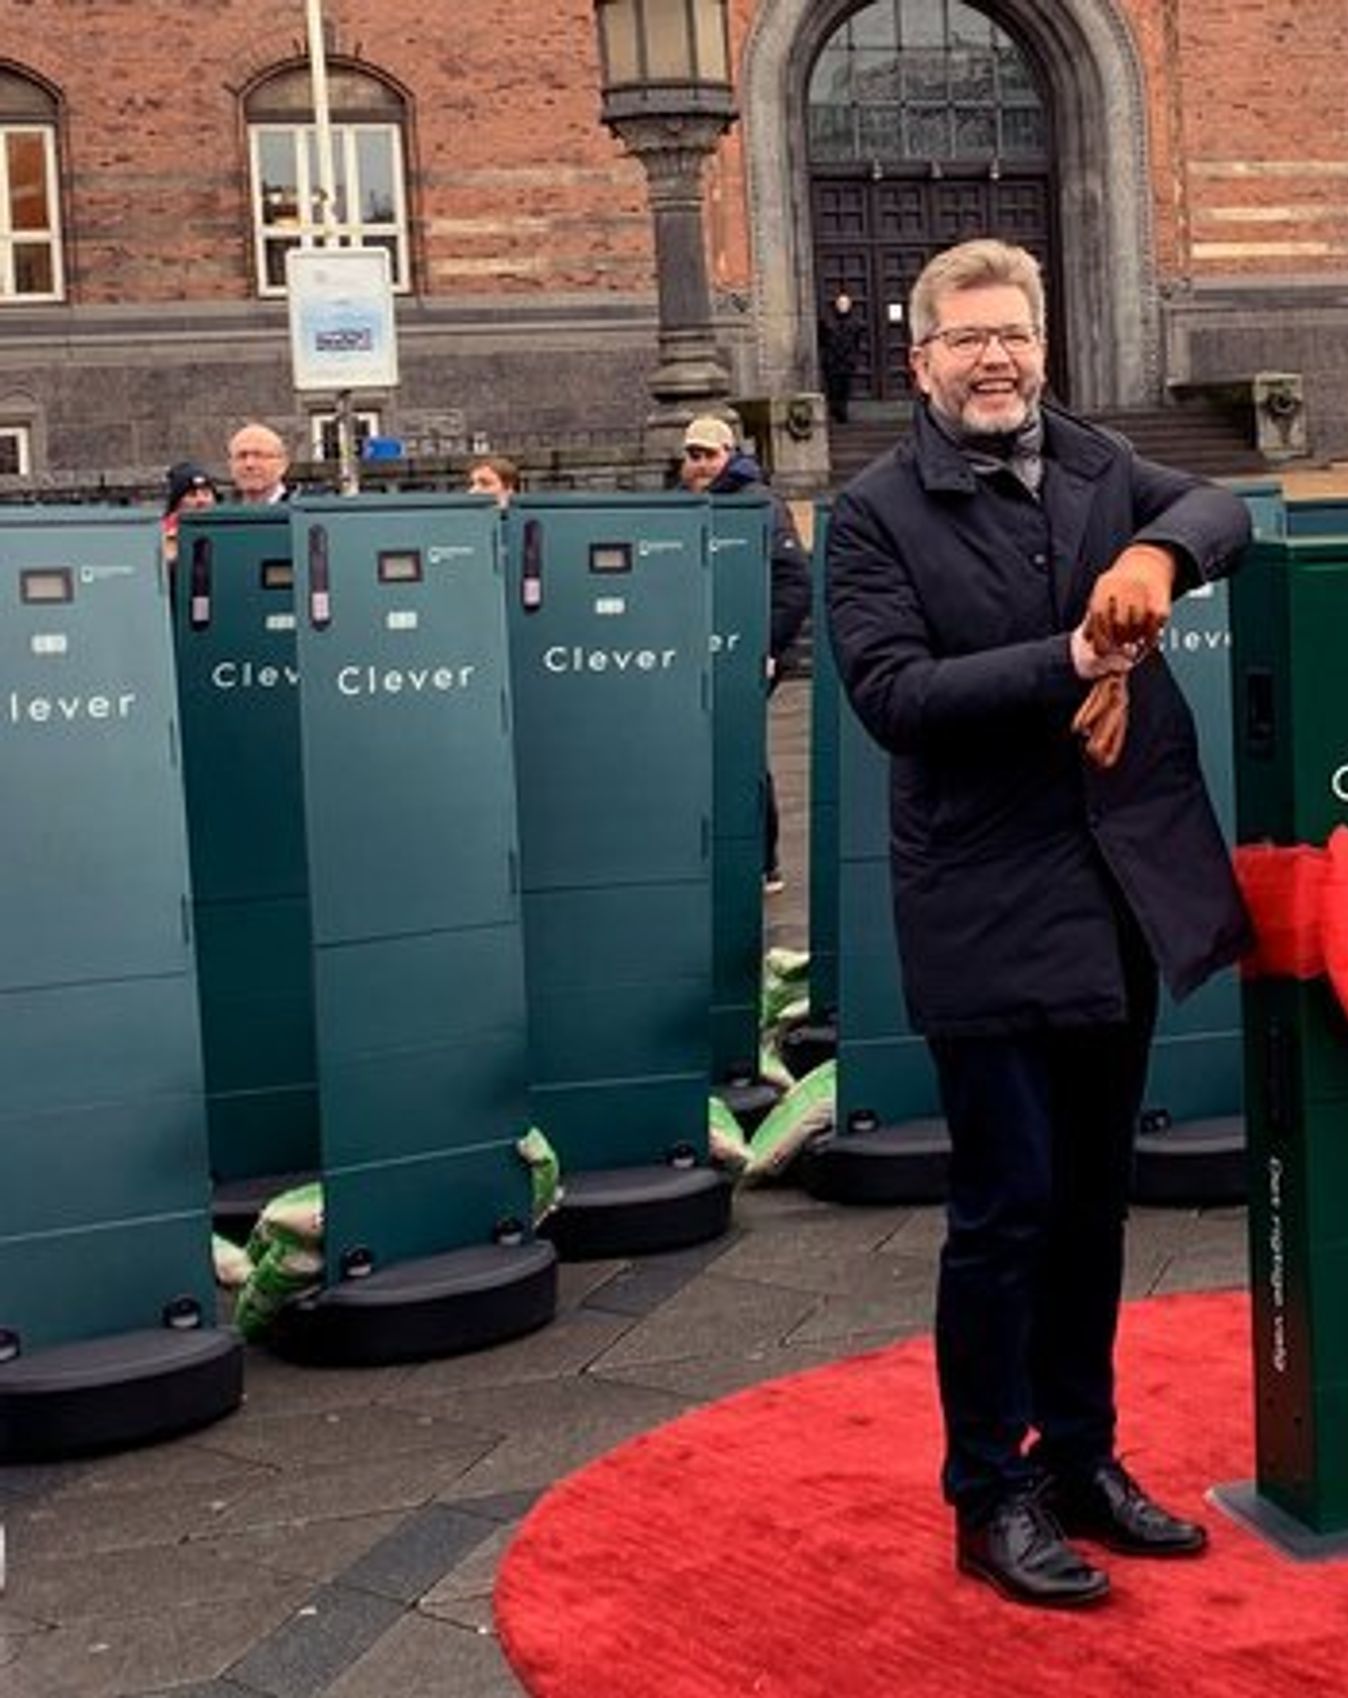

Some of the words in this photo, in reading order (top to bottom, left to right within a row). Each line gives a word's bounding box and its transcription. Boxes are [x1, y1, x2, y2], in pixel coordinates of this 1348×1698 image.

[544, 643, 677, 674] Clever
[337, 661, 476, 696] Clever
[10, 691, 136, 723] lever
